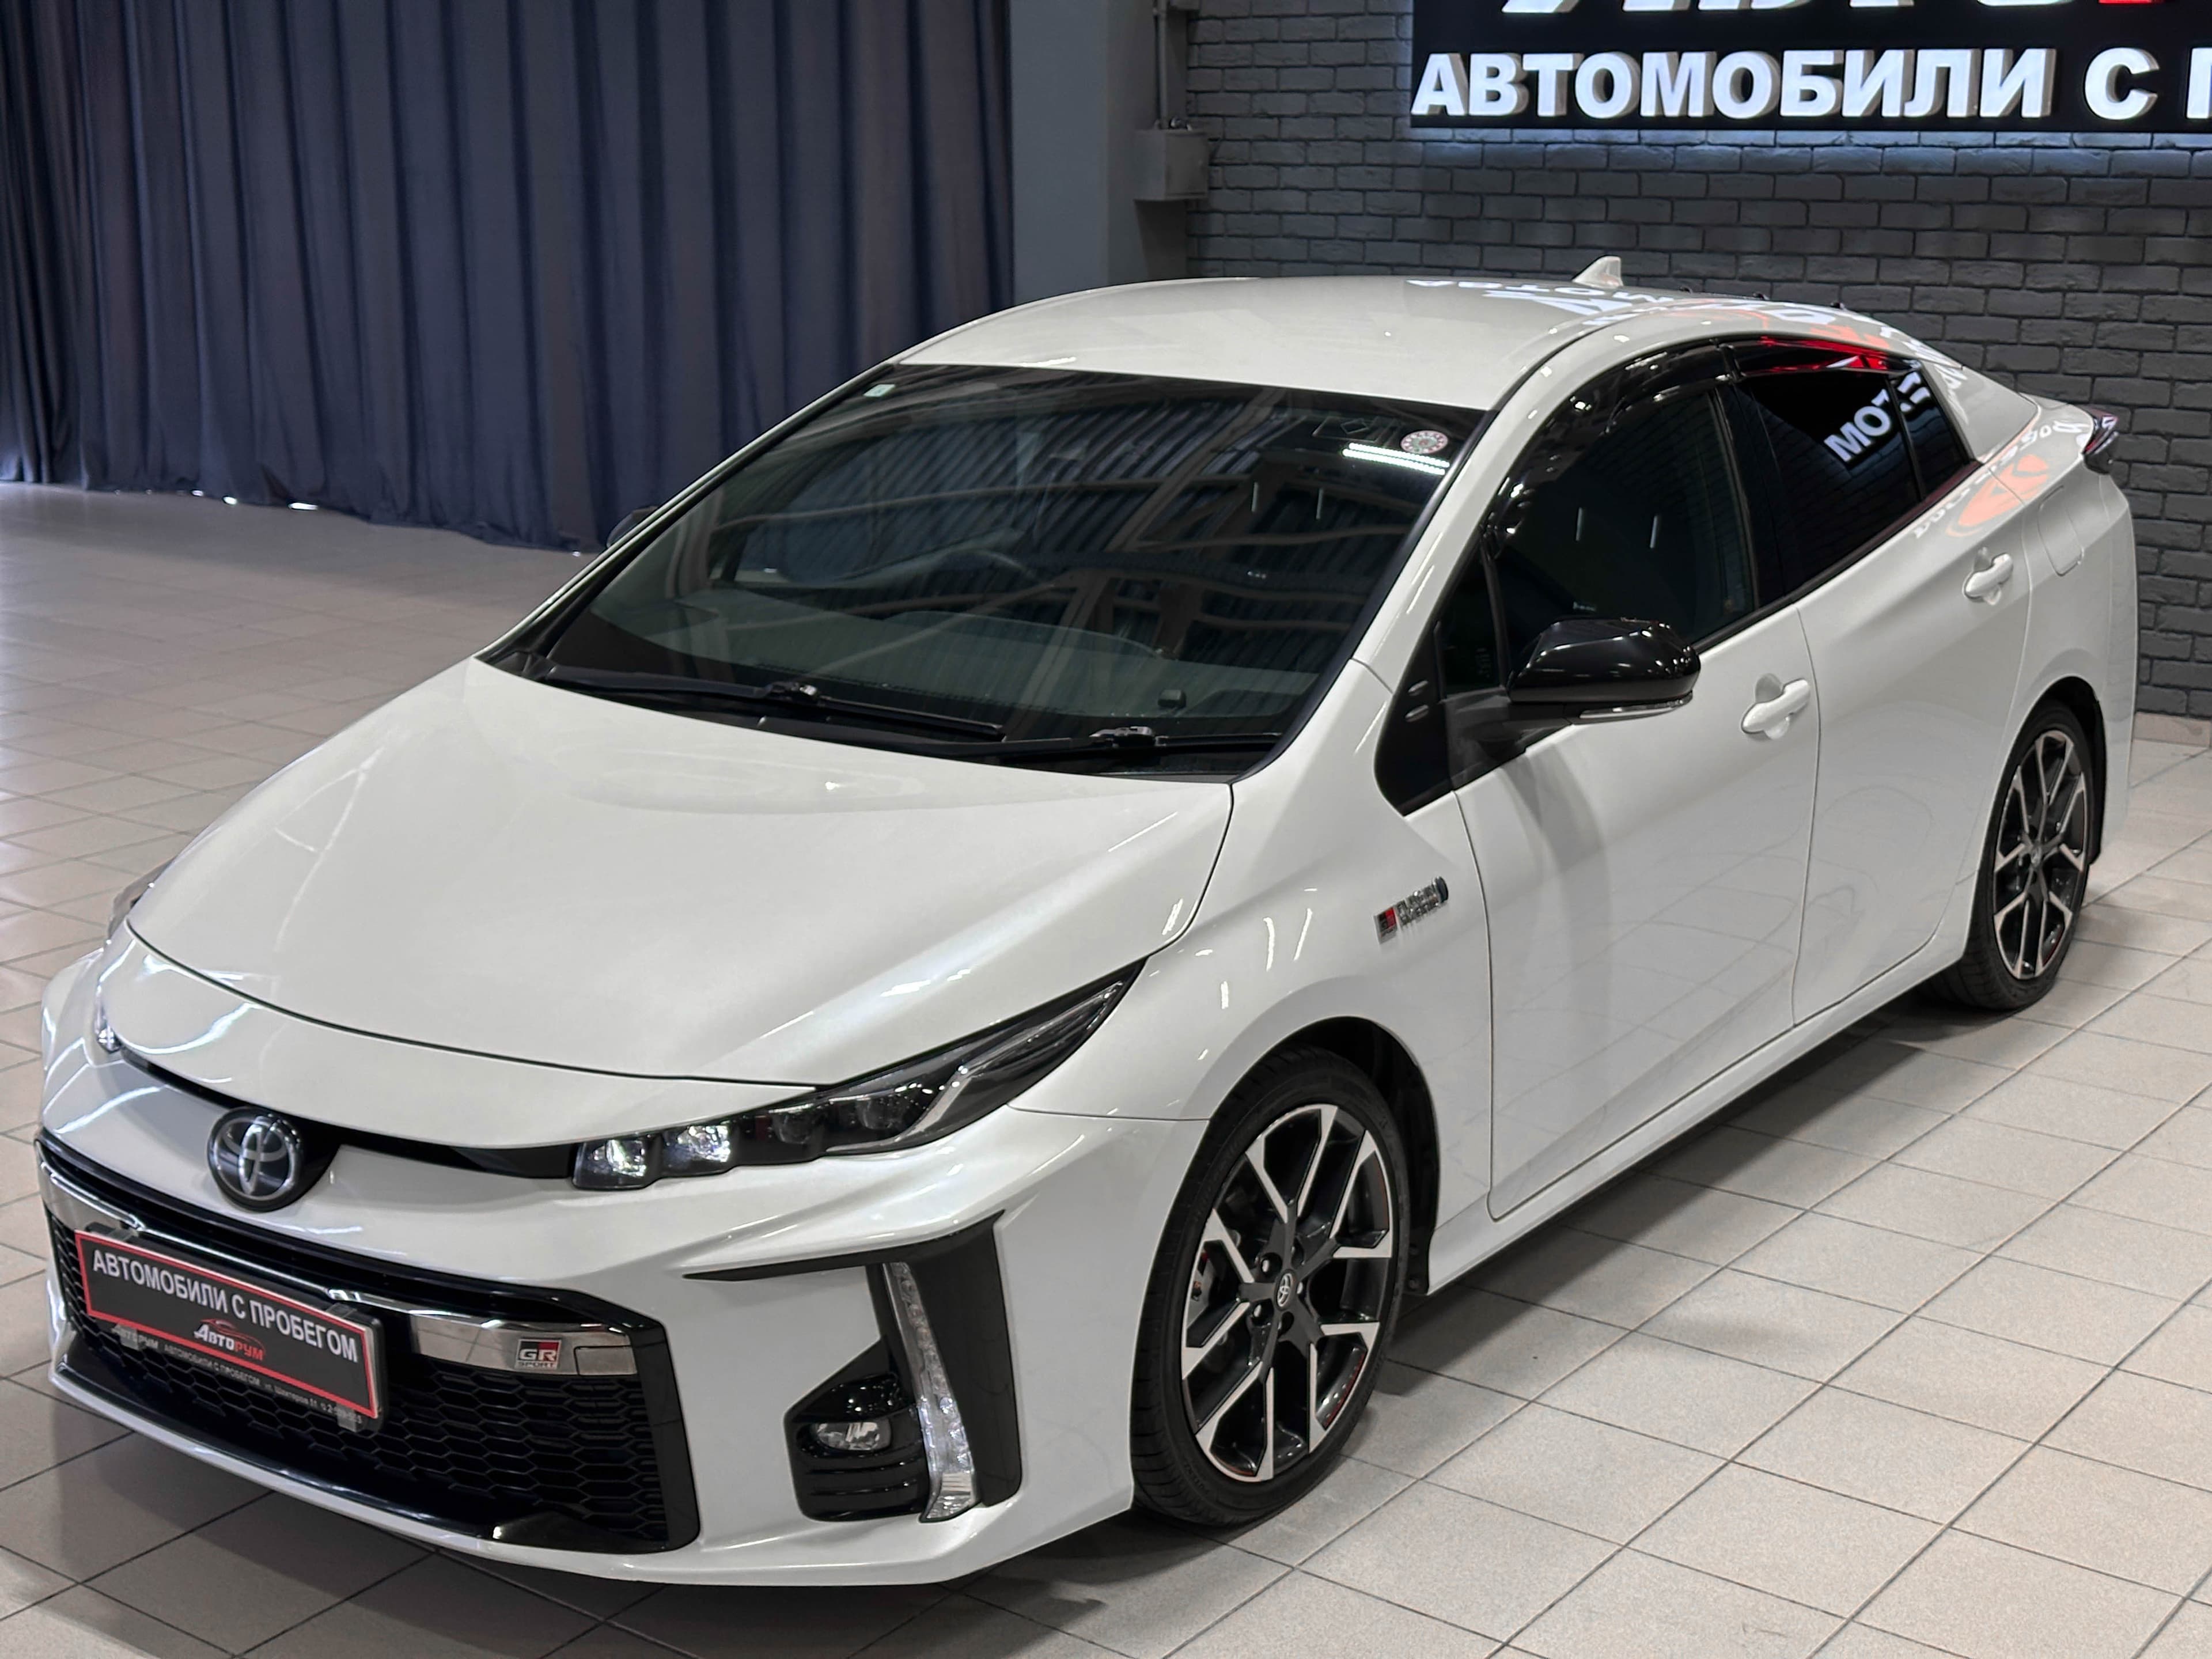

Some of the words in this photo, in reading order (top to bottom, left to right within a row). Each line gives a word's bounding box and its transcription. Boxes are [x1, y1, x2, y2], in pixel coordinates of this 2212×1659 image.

[1411, 47, 2055, 119] АВТОМОБИЛИ
[2084, 47, 2160, 120] С
[93, 1249, 228, 1313] АВТОМОБИЛИ
[232, 1294, 245, 1319] С
[249, 1300, 358, 1363] ПРОБЕГОМ
[519, 1349, 556, 1361] GR
